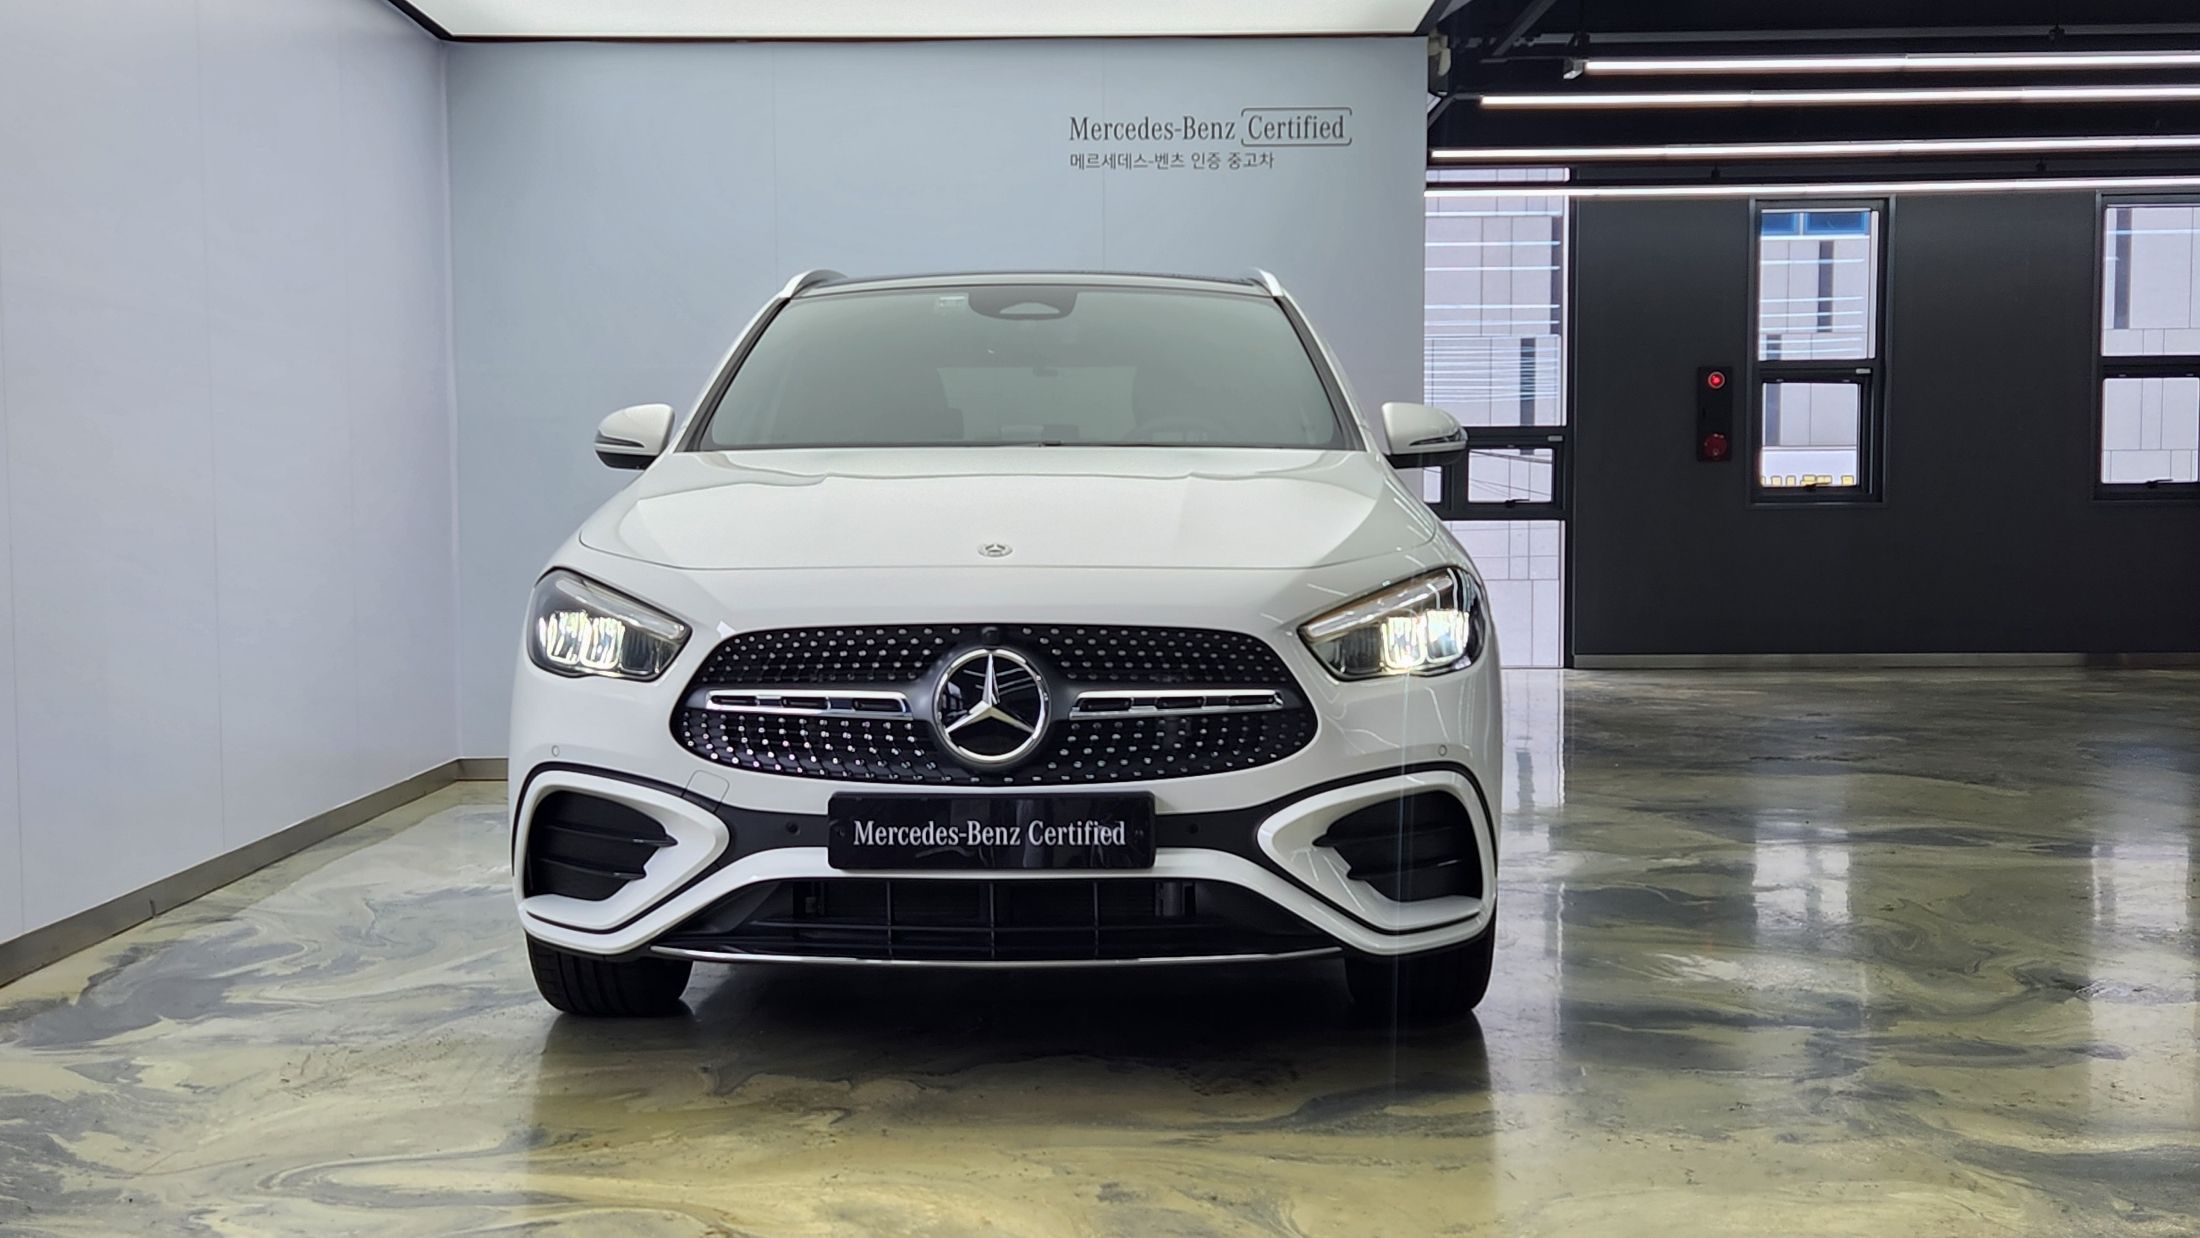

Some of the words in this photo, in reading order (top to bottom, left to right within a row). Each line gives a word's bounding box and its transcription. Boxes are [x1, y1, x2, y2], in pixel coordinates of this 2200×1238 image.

[1069, 114, 1236, 141] Mercedes-Benz
[1247, 113, 1345, 140] Certified
[1069, 152, 1185, 171] 메르세데스-벤츠
[1191, 152, 1221, 171] 인증
[1228, 152, 1275, 170] 중고차
[853, 820, 1021, 847] Mercedes-Benz
[1028, 819, 1126, 847] Certified
